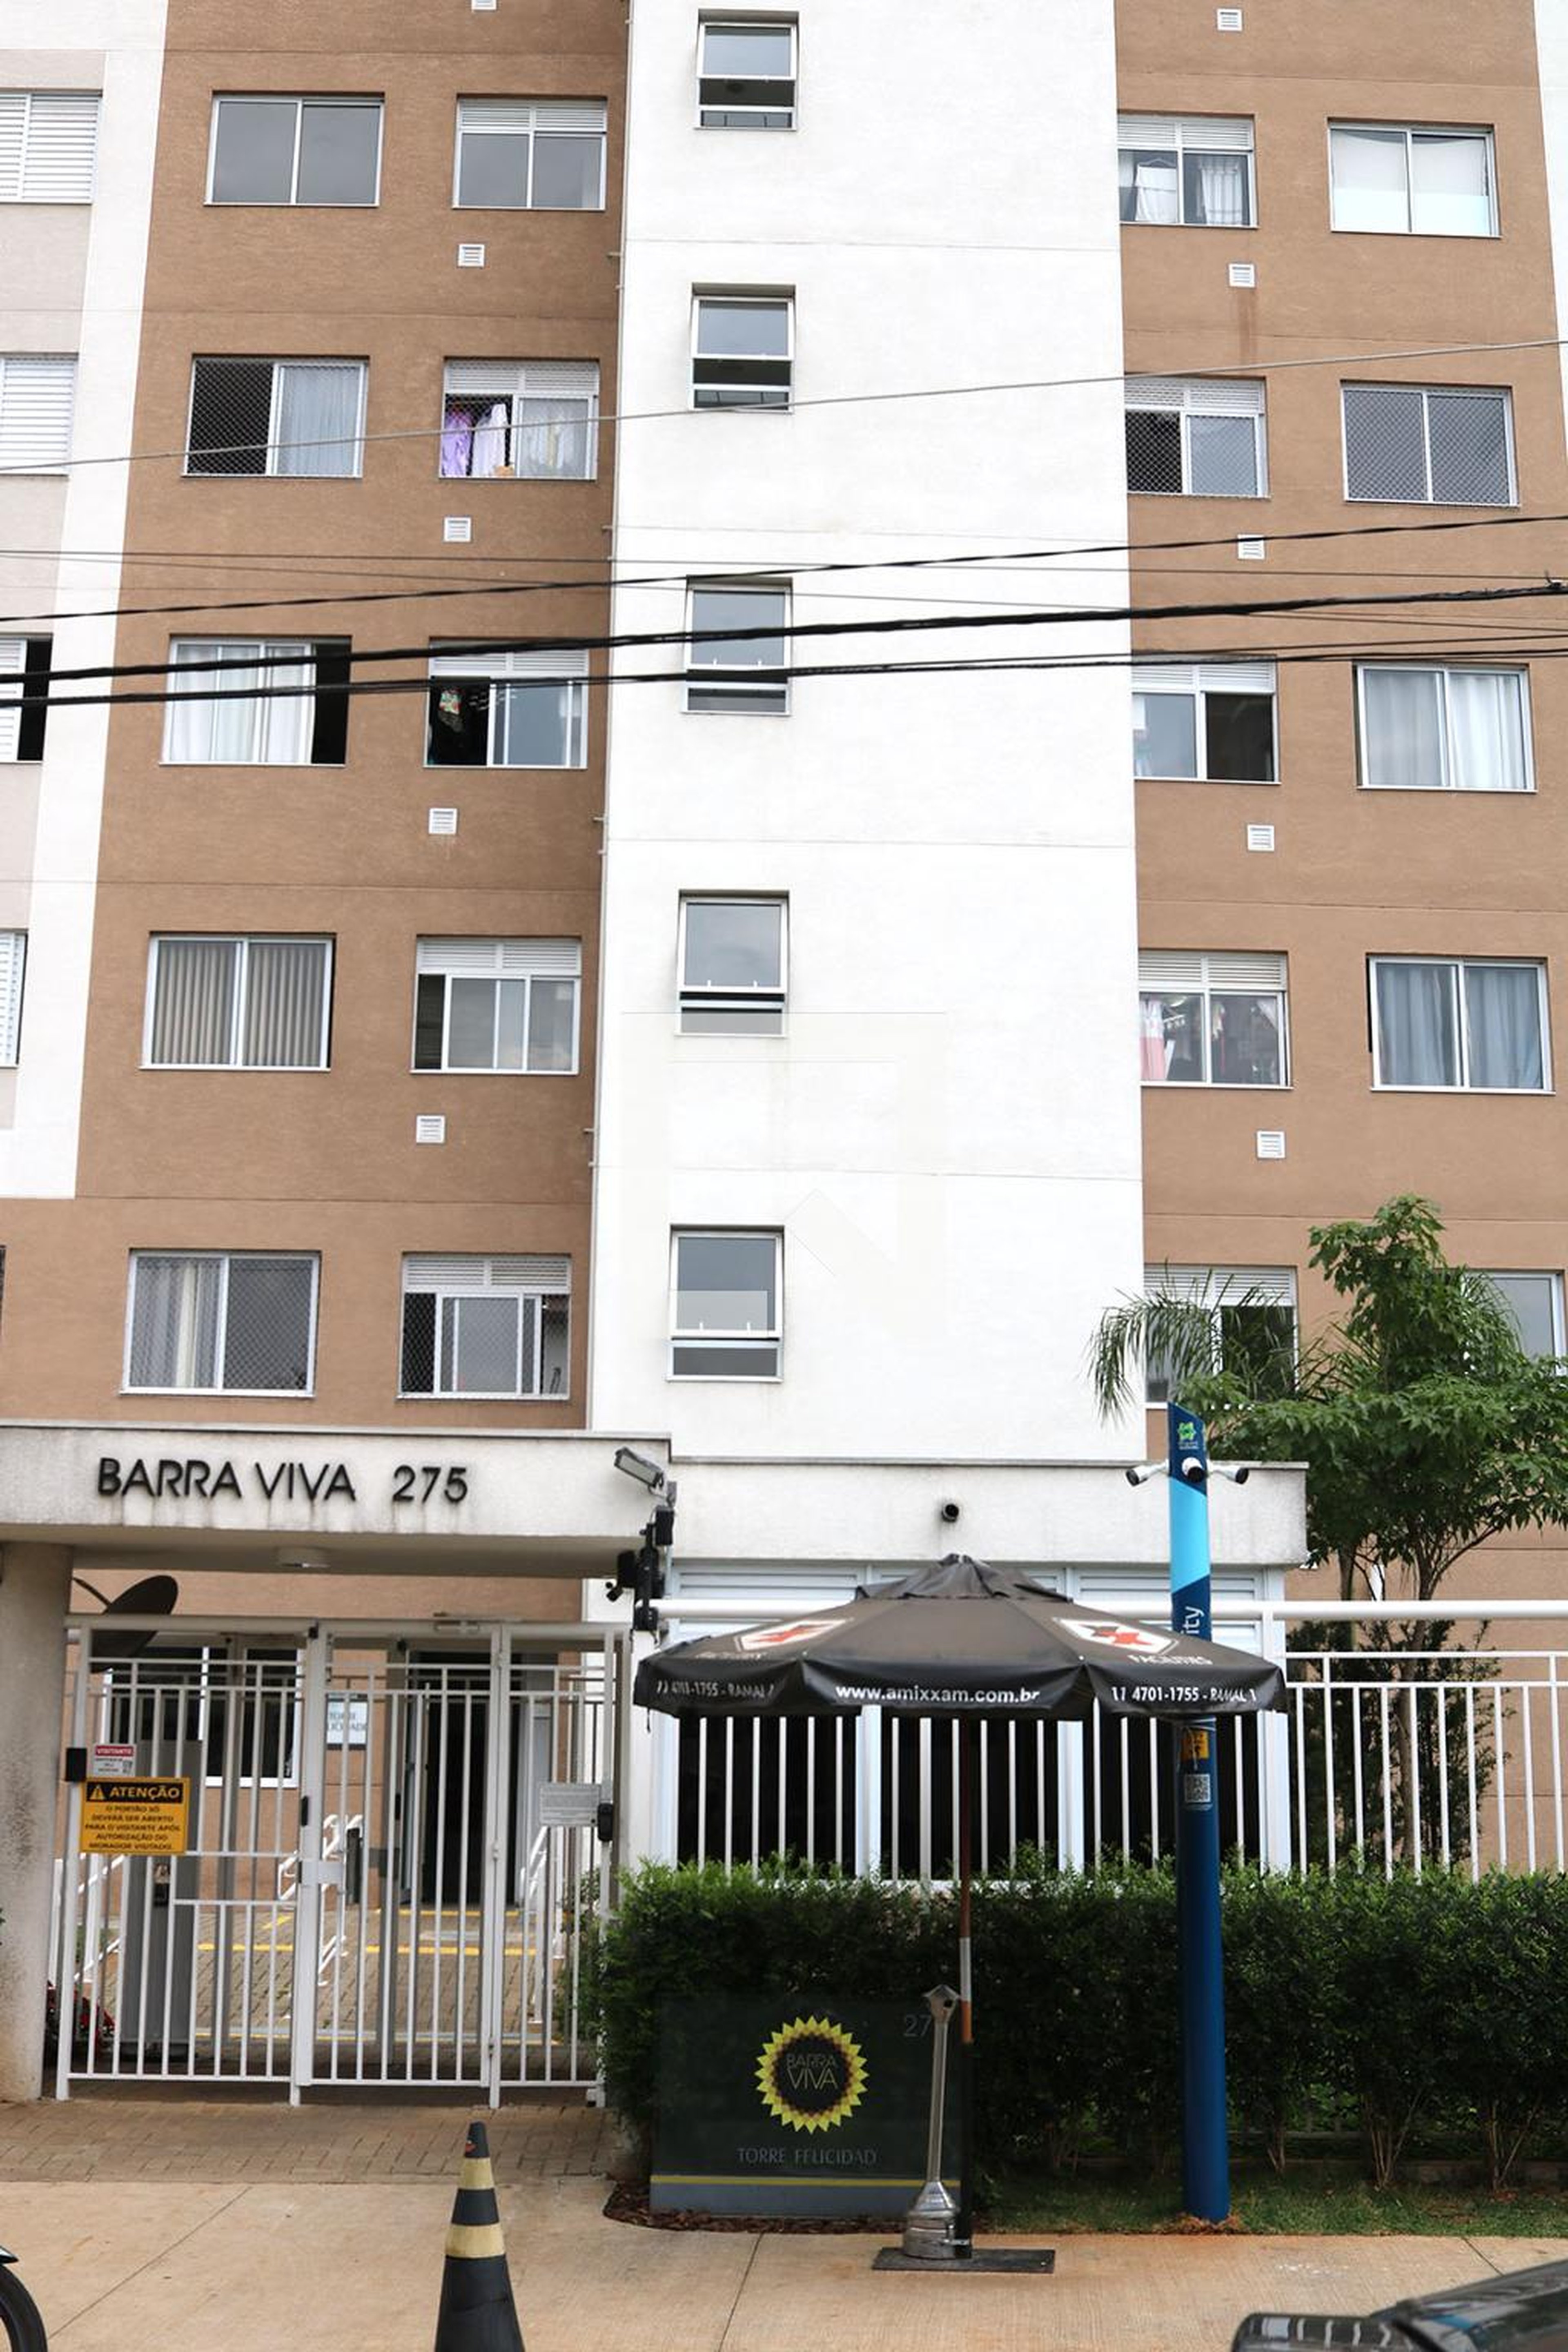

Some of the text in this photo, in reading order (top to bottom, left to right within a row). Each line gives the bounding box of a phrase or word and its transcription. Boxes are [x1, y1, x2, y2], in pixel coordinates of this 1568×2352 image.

[98, 1457, 468, 1503] BARRA VIVA 275
[835, 1685, 1040, 1703] www.amixxam.com.br
[1131, 1686, 1199, 1702] 4701-1755
[110, 1785, 180, 1800] ATENÇÃO
[786, 2053, 837, 2068] BARRA
[786, 2068, 838, 2090] VIVA
[737, 2148, 786, 2164] TORRE
